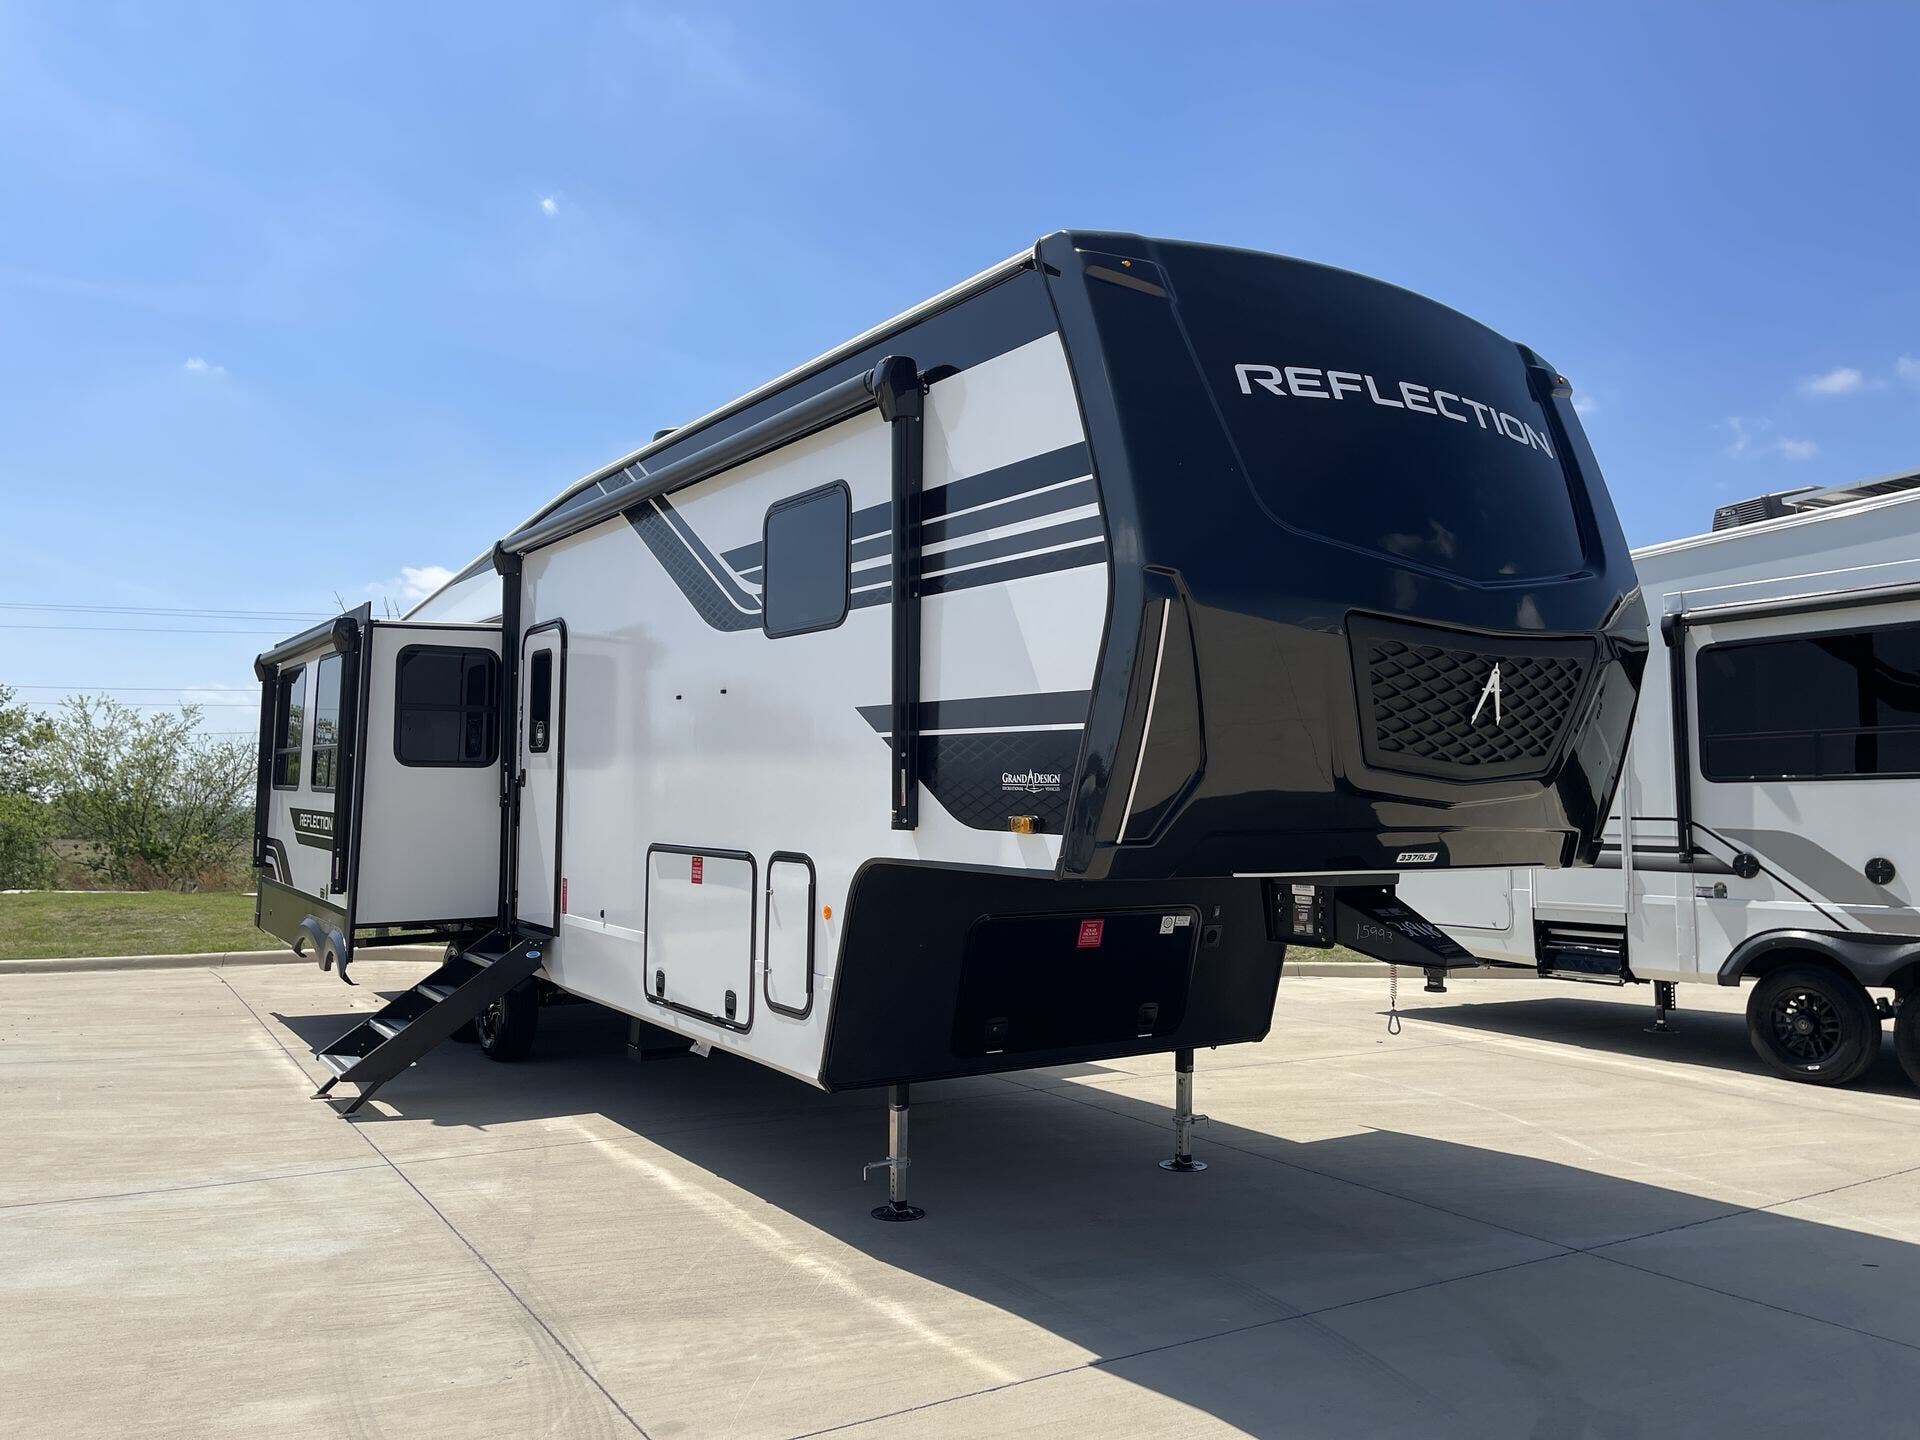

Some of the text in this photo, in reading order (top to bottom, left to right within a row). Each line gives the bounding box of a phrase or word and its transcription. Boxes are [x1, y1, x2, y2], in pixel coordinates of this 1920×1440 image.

[1234, 363, 1554, 459] REFLECTION
[1002, 772, 1060, 783] GRAND DESIGN
[300, 813, 333, 830] REFLECTION
[1399, 853, 1435, 862] 337RLS
[1356, 923, 1393, 945] 15993
